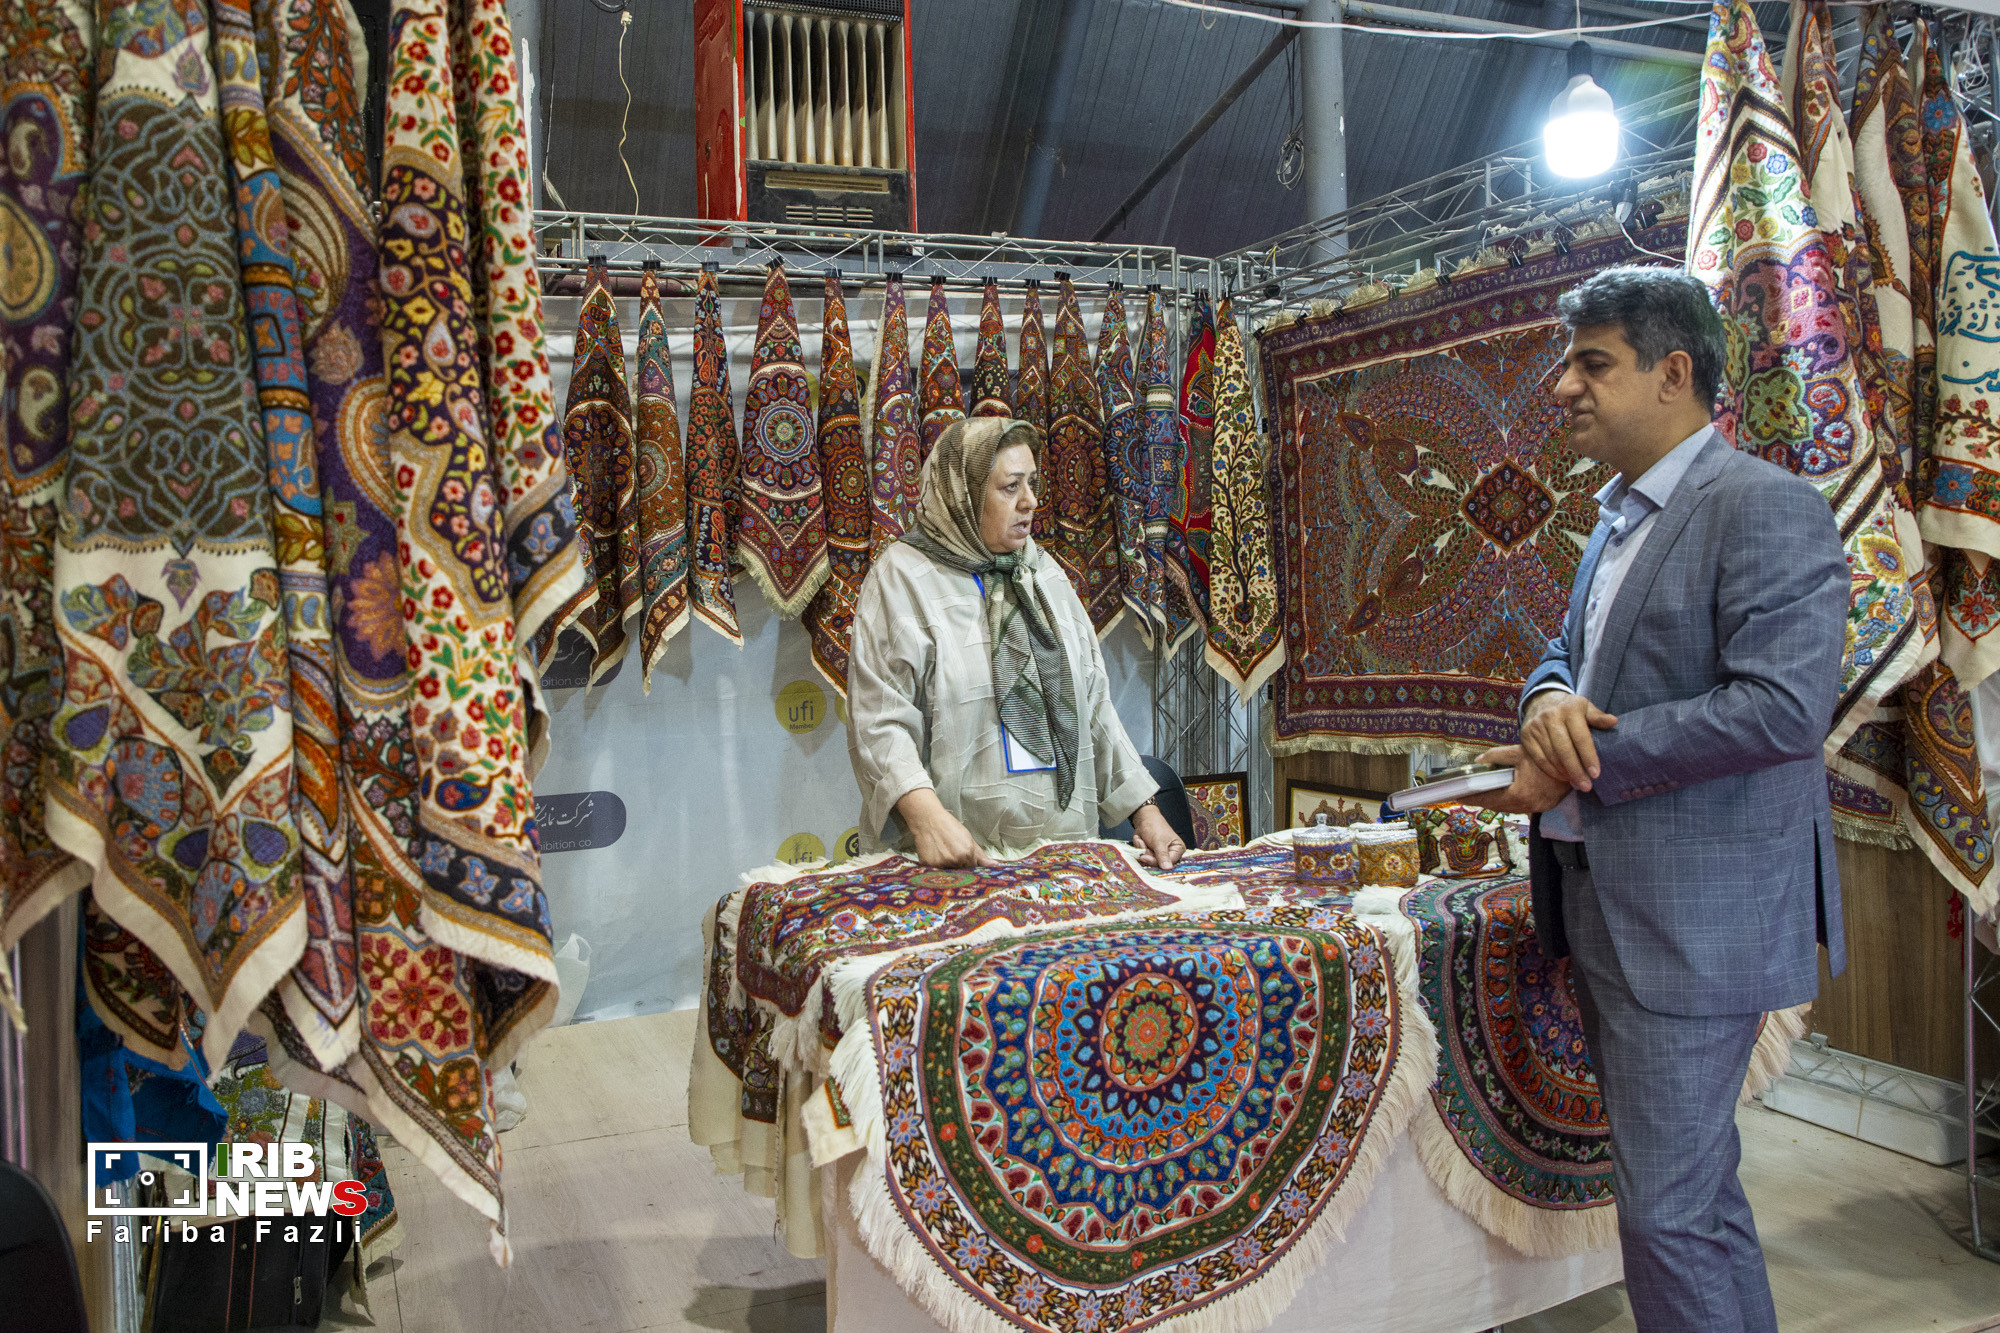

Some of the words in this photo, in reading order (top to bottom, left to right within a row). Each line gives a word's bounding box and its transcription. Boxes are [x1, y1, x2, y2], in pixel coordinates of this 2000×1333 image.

[574, 677, 588, 685] co
[788, 700, 814, 723] ufi
[535, 803, 556, 828] نمایش
[556, 793, 594, 828] شرکت
[578, 838, 592, 848] co
